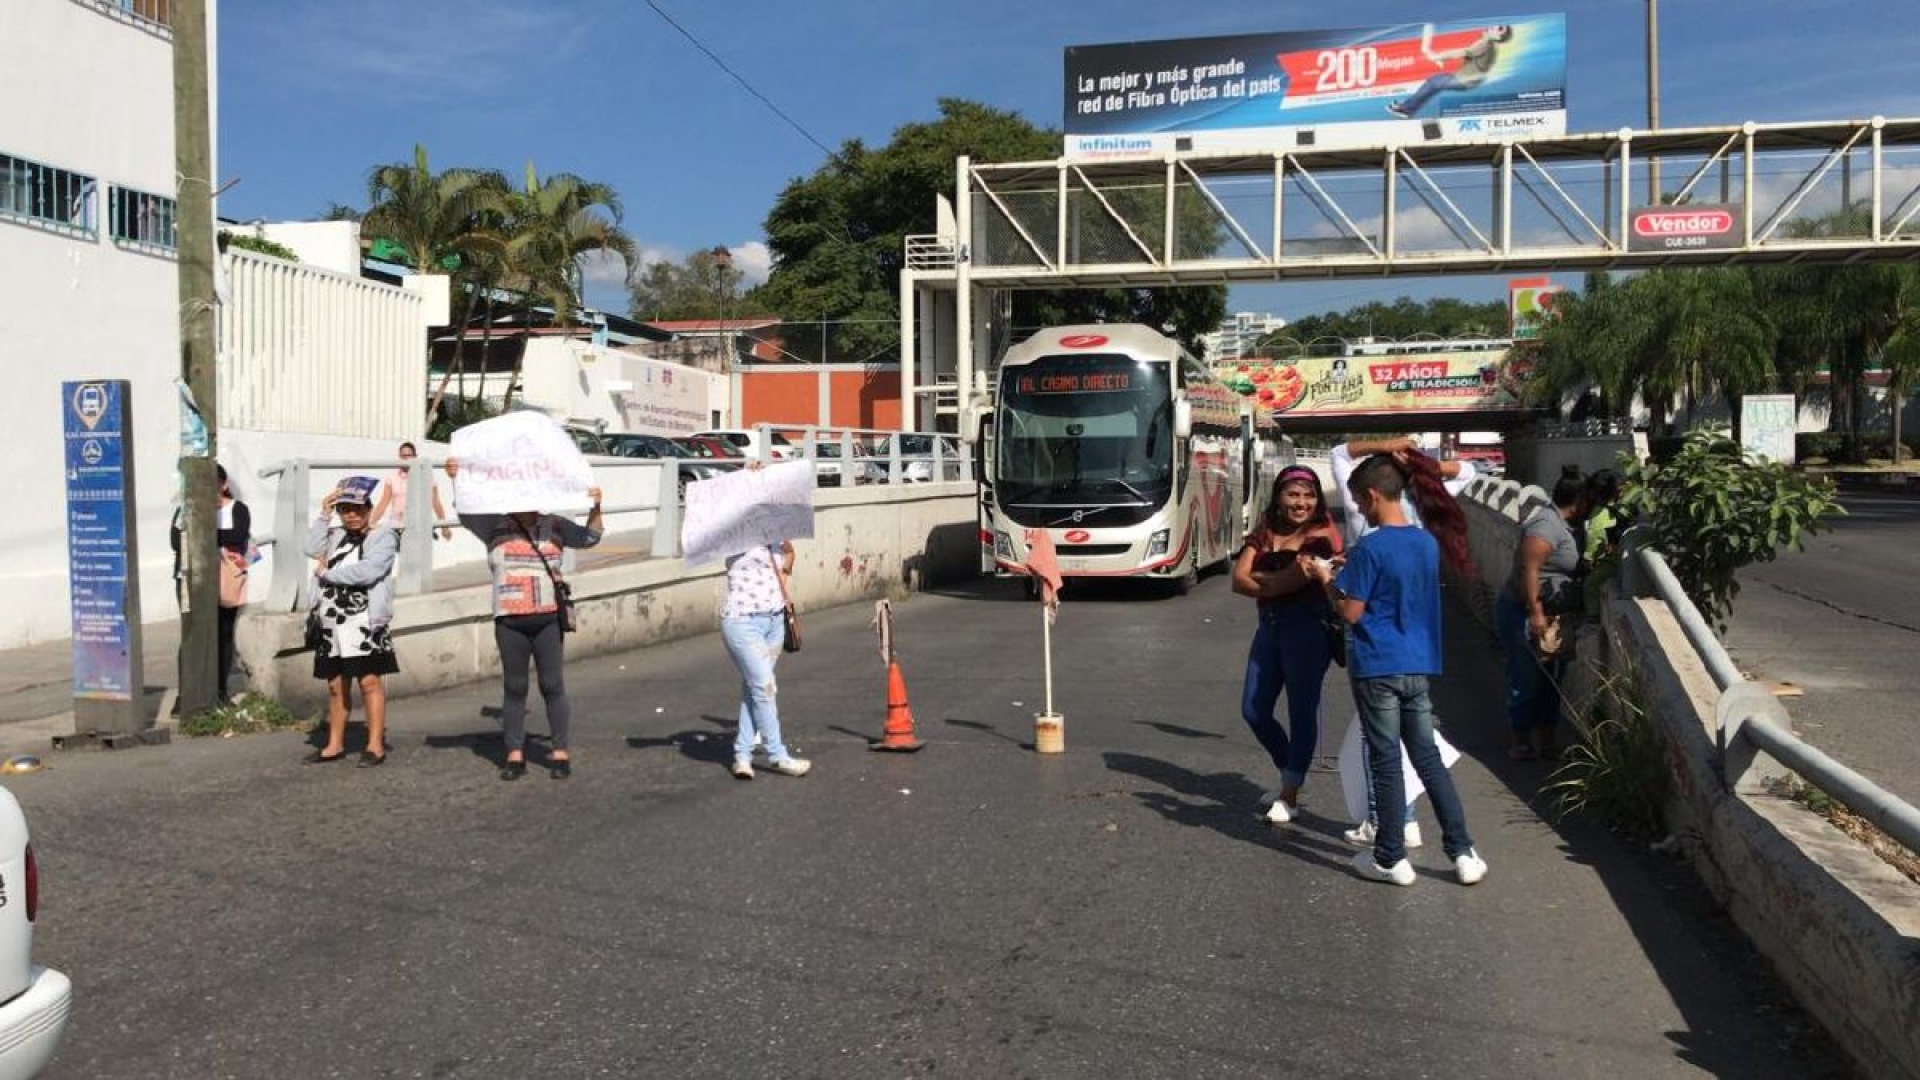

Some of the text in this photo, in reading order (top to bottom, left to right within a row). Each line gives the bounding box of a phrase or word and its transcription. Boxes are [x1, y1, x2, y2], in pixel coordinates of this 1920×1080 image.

[1077, 58, 1246, 93] La mejor y más grande
[1316, 48, 1377, 92] 200
[1077, 74, 1282, 115] red de Fibra Óptica del país
[1487, 116, 1545, 128] TELMEX
[1079, 137, 1152, 150] infinitum
[1648, 216, 1721, 232] Vendor
[1374, 364, 1443, 380] 32 AÑOS
